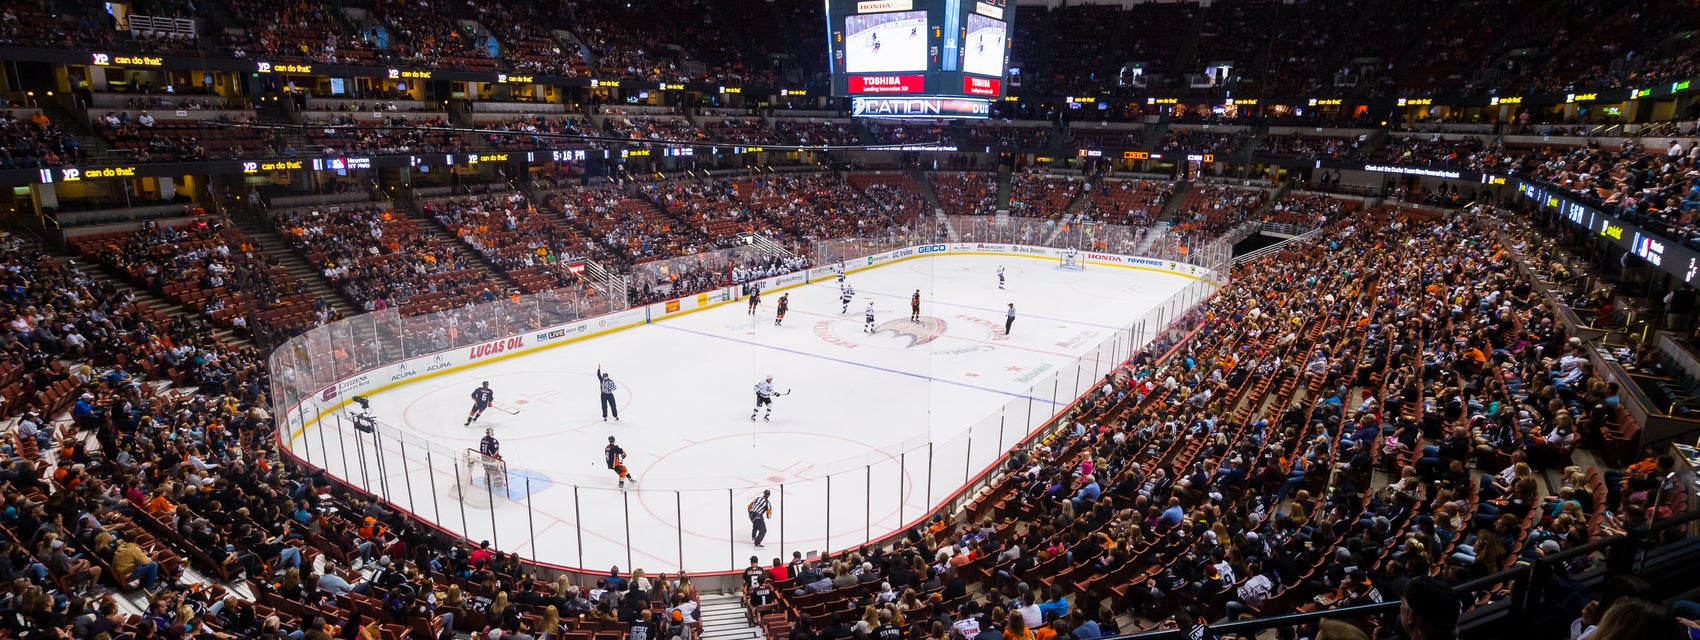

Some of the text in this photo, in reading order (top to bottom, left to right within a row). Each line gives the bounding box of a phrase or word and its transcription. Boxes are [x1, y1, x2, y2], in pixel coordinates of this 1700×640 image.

[132, 57, 143, 65] do
[287, 64, 296, 72] do
[863, 77, 901, 86] TOSHIBA
[972, 78, 990, 87] TOSHIBA
[553, 150, 585, 160] 5:16 PM
[85, 170, 102, 178] can
[103, 168, 115, 177] do
[918, 245, 946, 253] GEICO
[893, 251, 899, 259] UC
[900, 249, 913, 257] Irvine
[1088, 254, 1122, 262] HONDA
[1689, 258, 1696, 268] 3
[1691, 267, 1698, 277] F
[549, 330, 565, 338] LIVE
[469, 336, 524, 360] LUCAS OIL
[427, 362, 452, 372] ACURA
[391, 370, 416, 381] ACURA
[481, 393, 487, 401] 6
[761, 596, 766, 605] 1
